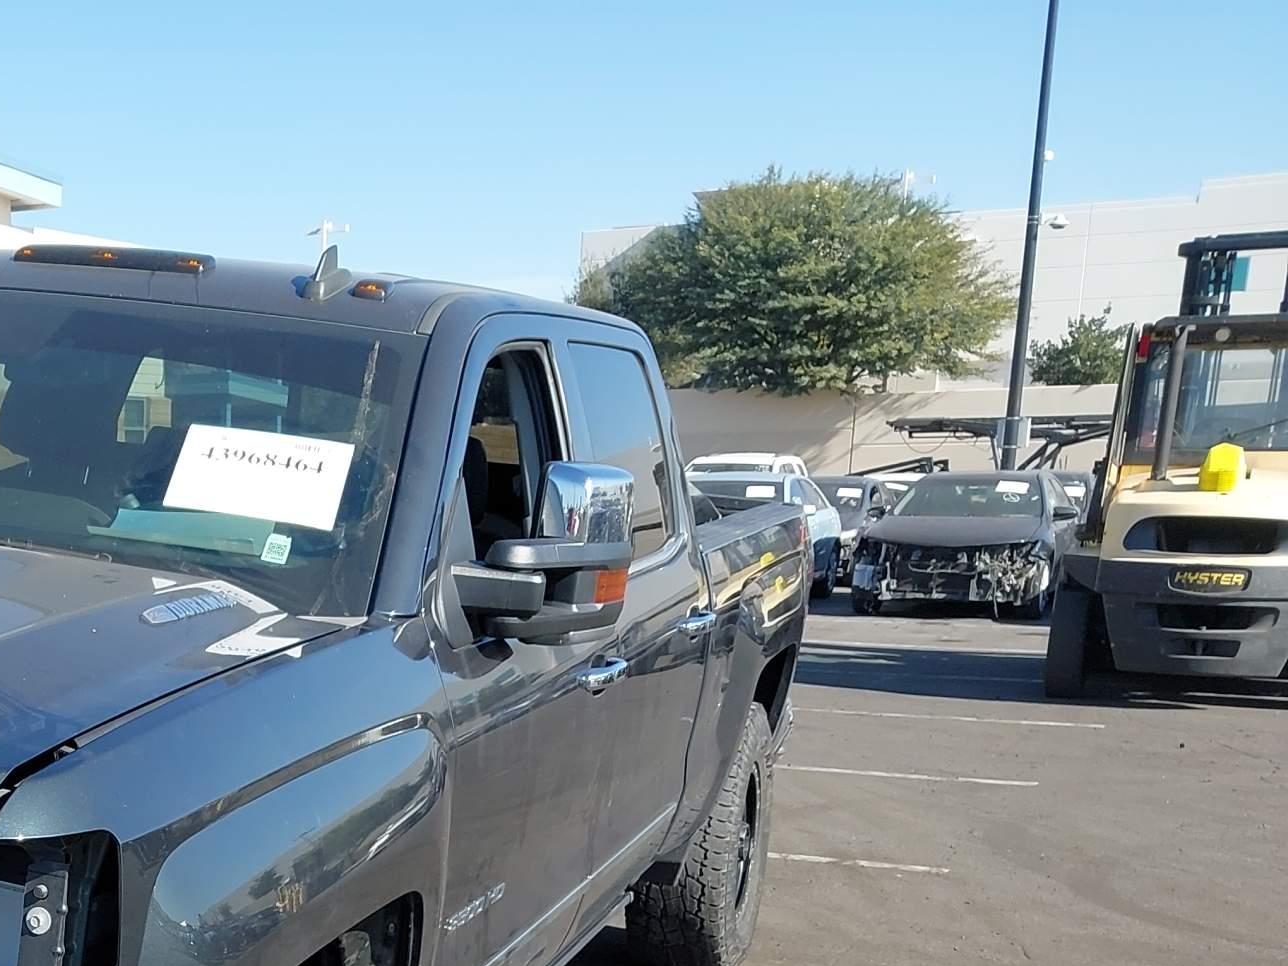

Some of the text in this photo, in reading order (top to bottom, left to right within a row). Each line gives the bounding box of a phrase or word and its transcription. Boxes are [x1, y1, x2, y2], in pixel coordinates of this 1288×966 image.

[200, 446, 324, 474] 43968464
[1174, 571, 1246, 586] HYSTER
[165, 588, 237, 620] DURAM
